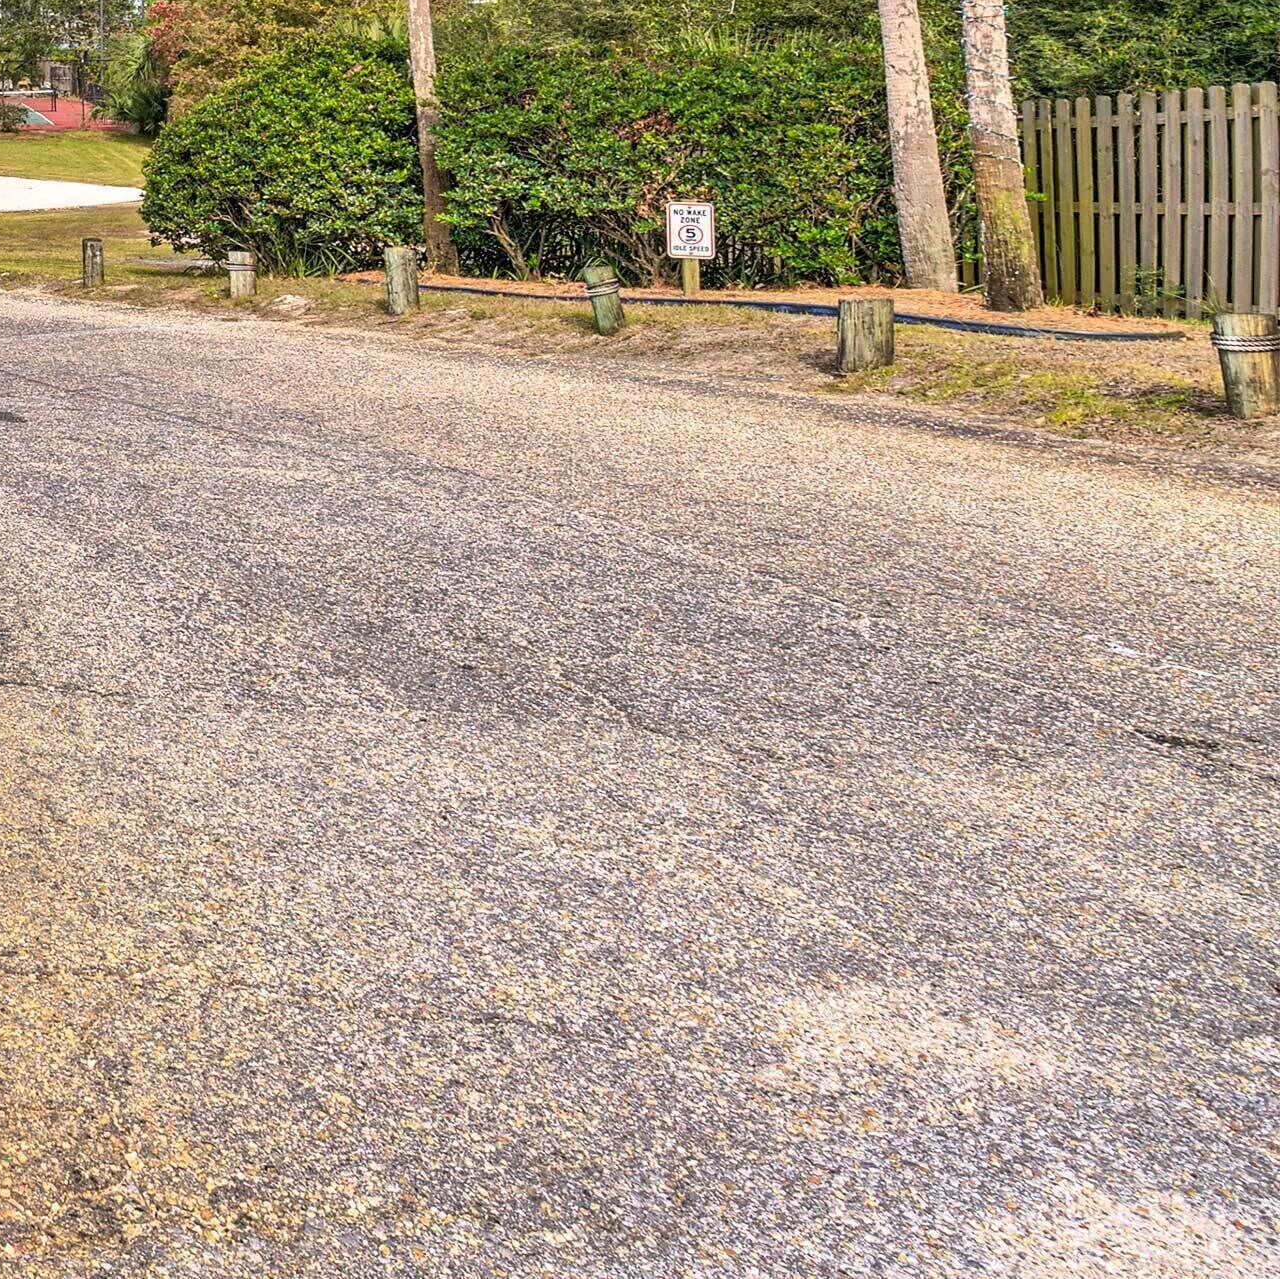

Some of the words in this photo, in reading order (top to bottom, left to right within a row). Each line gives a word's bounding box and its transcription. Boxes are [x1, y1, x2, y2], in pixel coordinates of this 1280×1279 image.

[686, 209, 707, 217] WAKE
[680, 216, 701, 224] ZONE
[686, 228, 696, 238] 5
